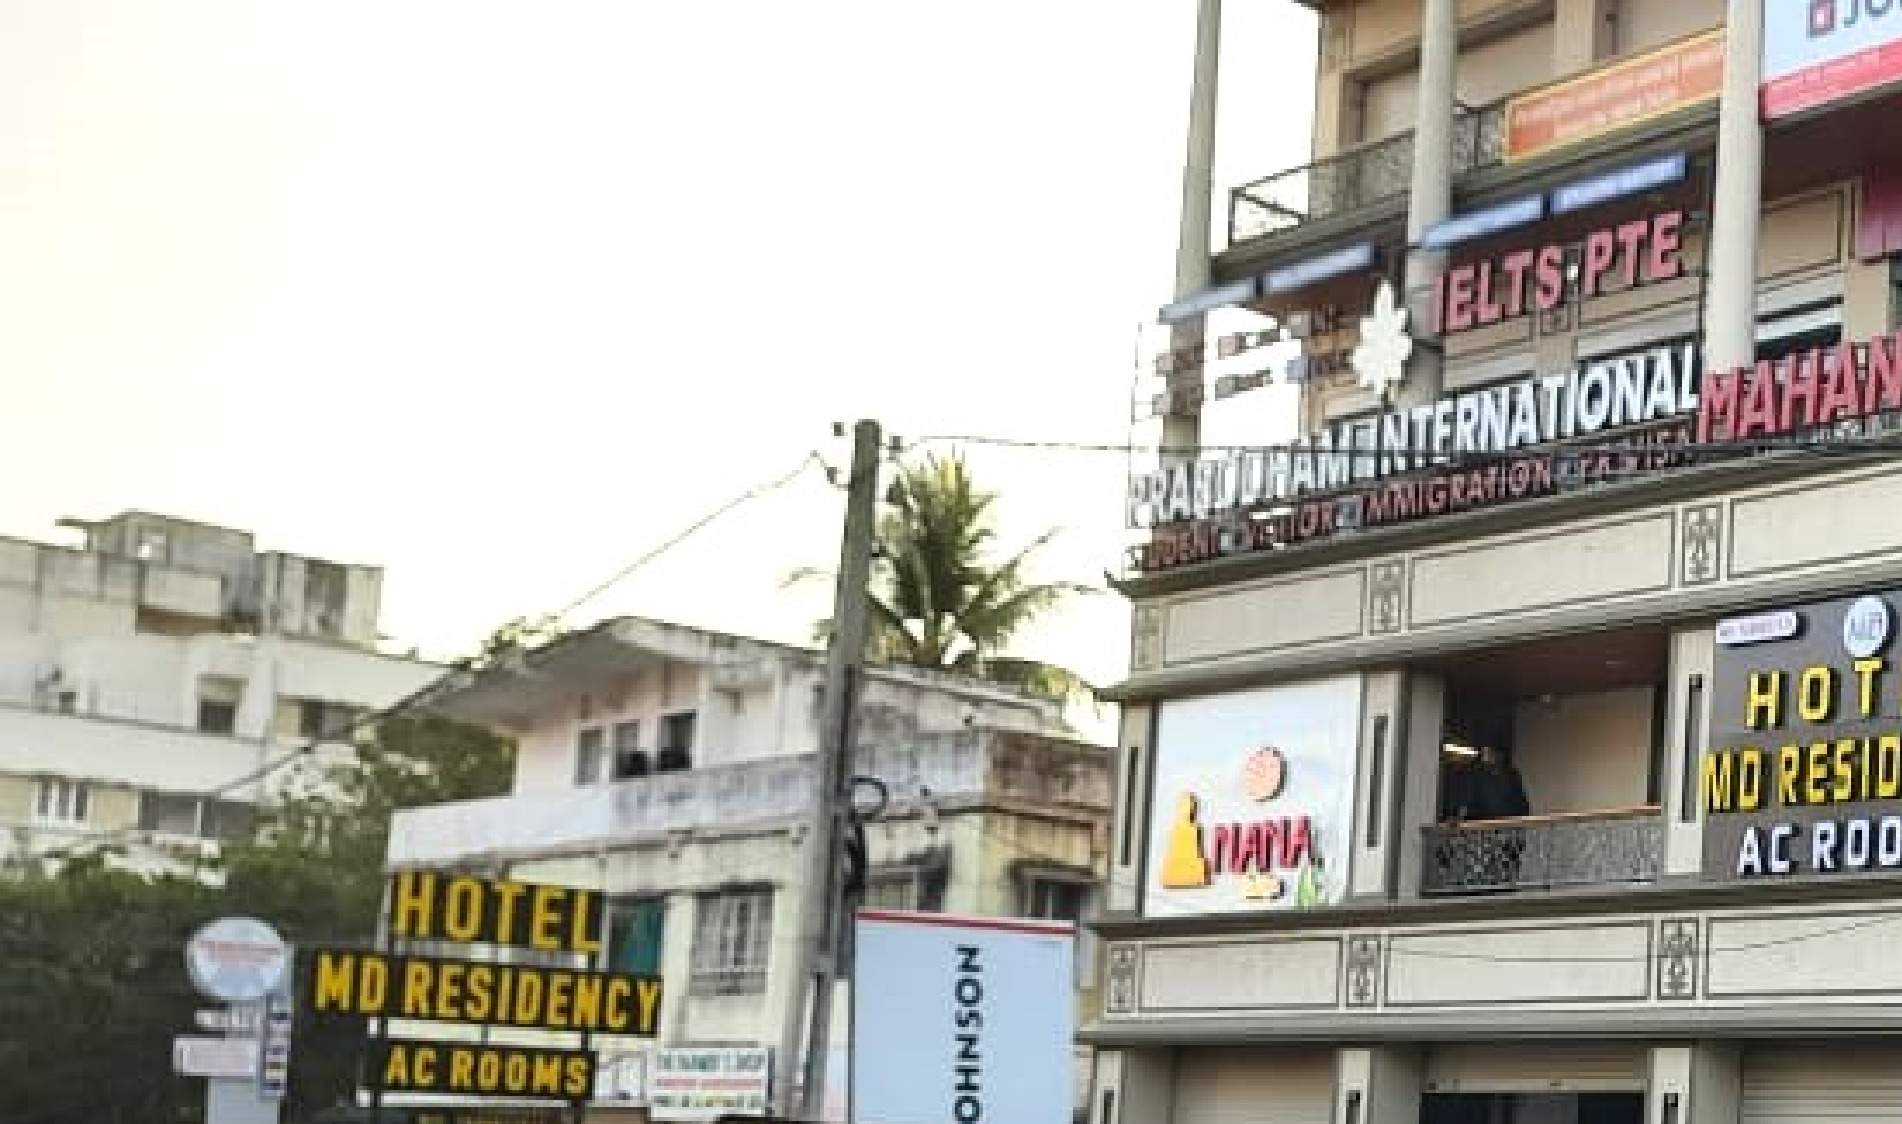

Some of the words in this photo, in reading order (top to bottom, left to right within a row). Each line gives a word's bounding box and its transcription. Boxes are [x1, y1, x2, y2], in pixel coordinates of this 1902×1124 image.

[1434, 244, 1565, 333] IELTS
[1584, 210, 1684, 297] PTE
[1367, 345, 1697, 475] INTERNATIONAL
[1364, 456, 1551, 524] IMMIGRATION
[1705, 750, 1762, 810] MD
[1738, 825, 1793, 873] AC
[393, 871, 602, 953] HOTEL
[314, 952, 389, 1012] MD
[404, 958, 661, 1033] RESIDENCY
[386, 1045, 437, 1085] AC
[449, 1050, 588, 1096] ROOMS
